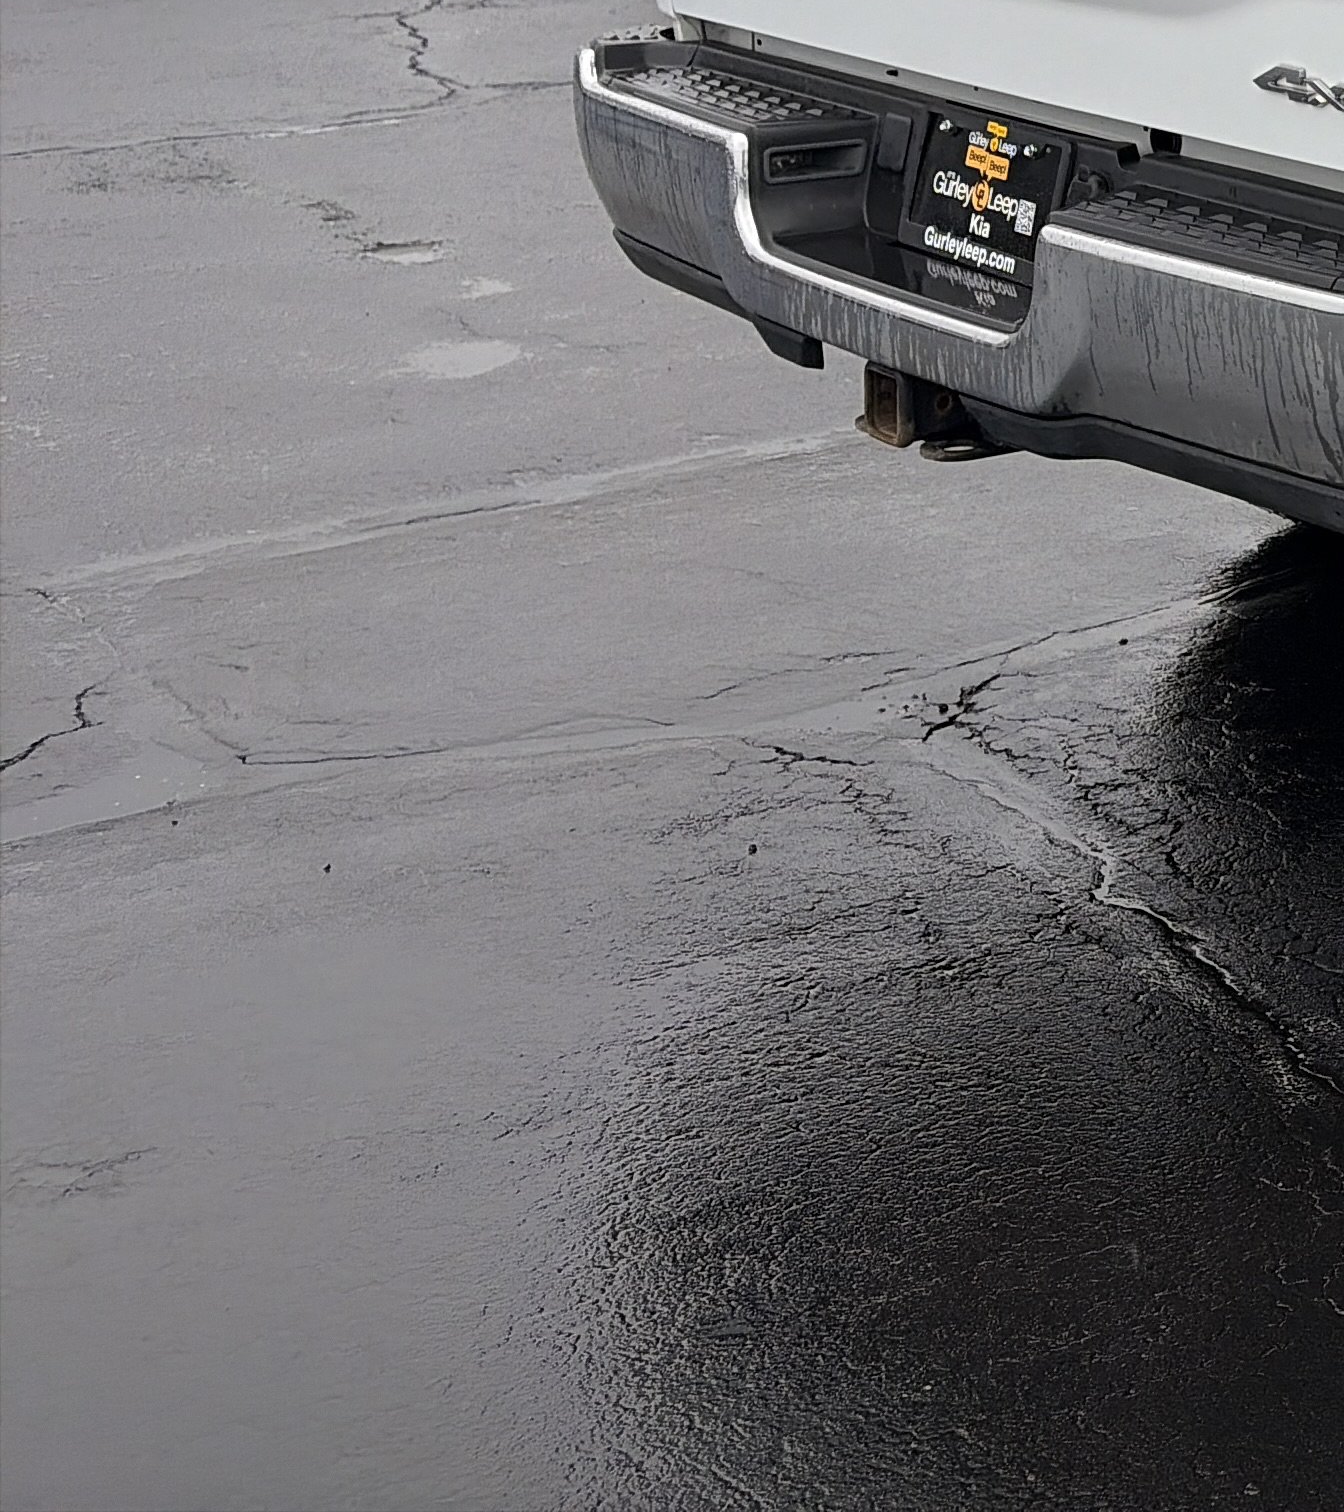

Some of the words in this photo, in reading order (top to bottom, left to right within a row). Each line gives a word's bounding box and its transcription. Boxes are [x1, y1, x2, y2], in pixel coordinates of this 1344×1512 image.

[932, 170, 975, 208] Gurley
[987, 187, 1018, 222] Leep
[924, 225, 1016, 275] Gurleyleep.com
[968, 212, 991, 239] Kia
